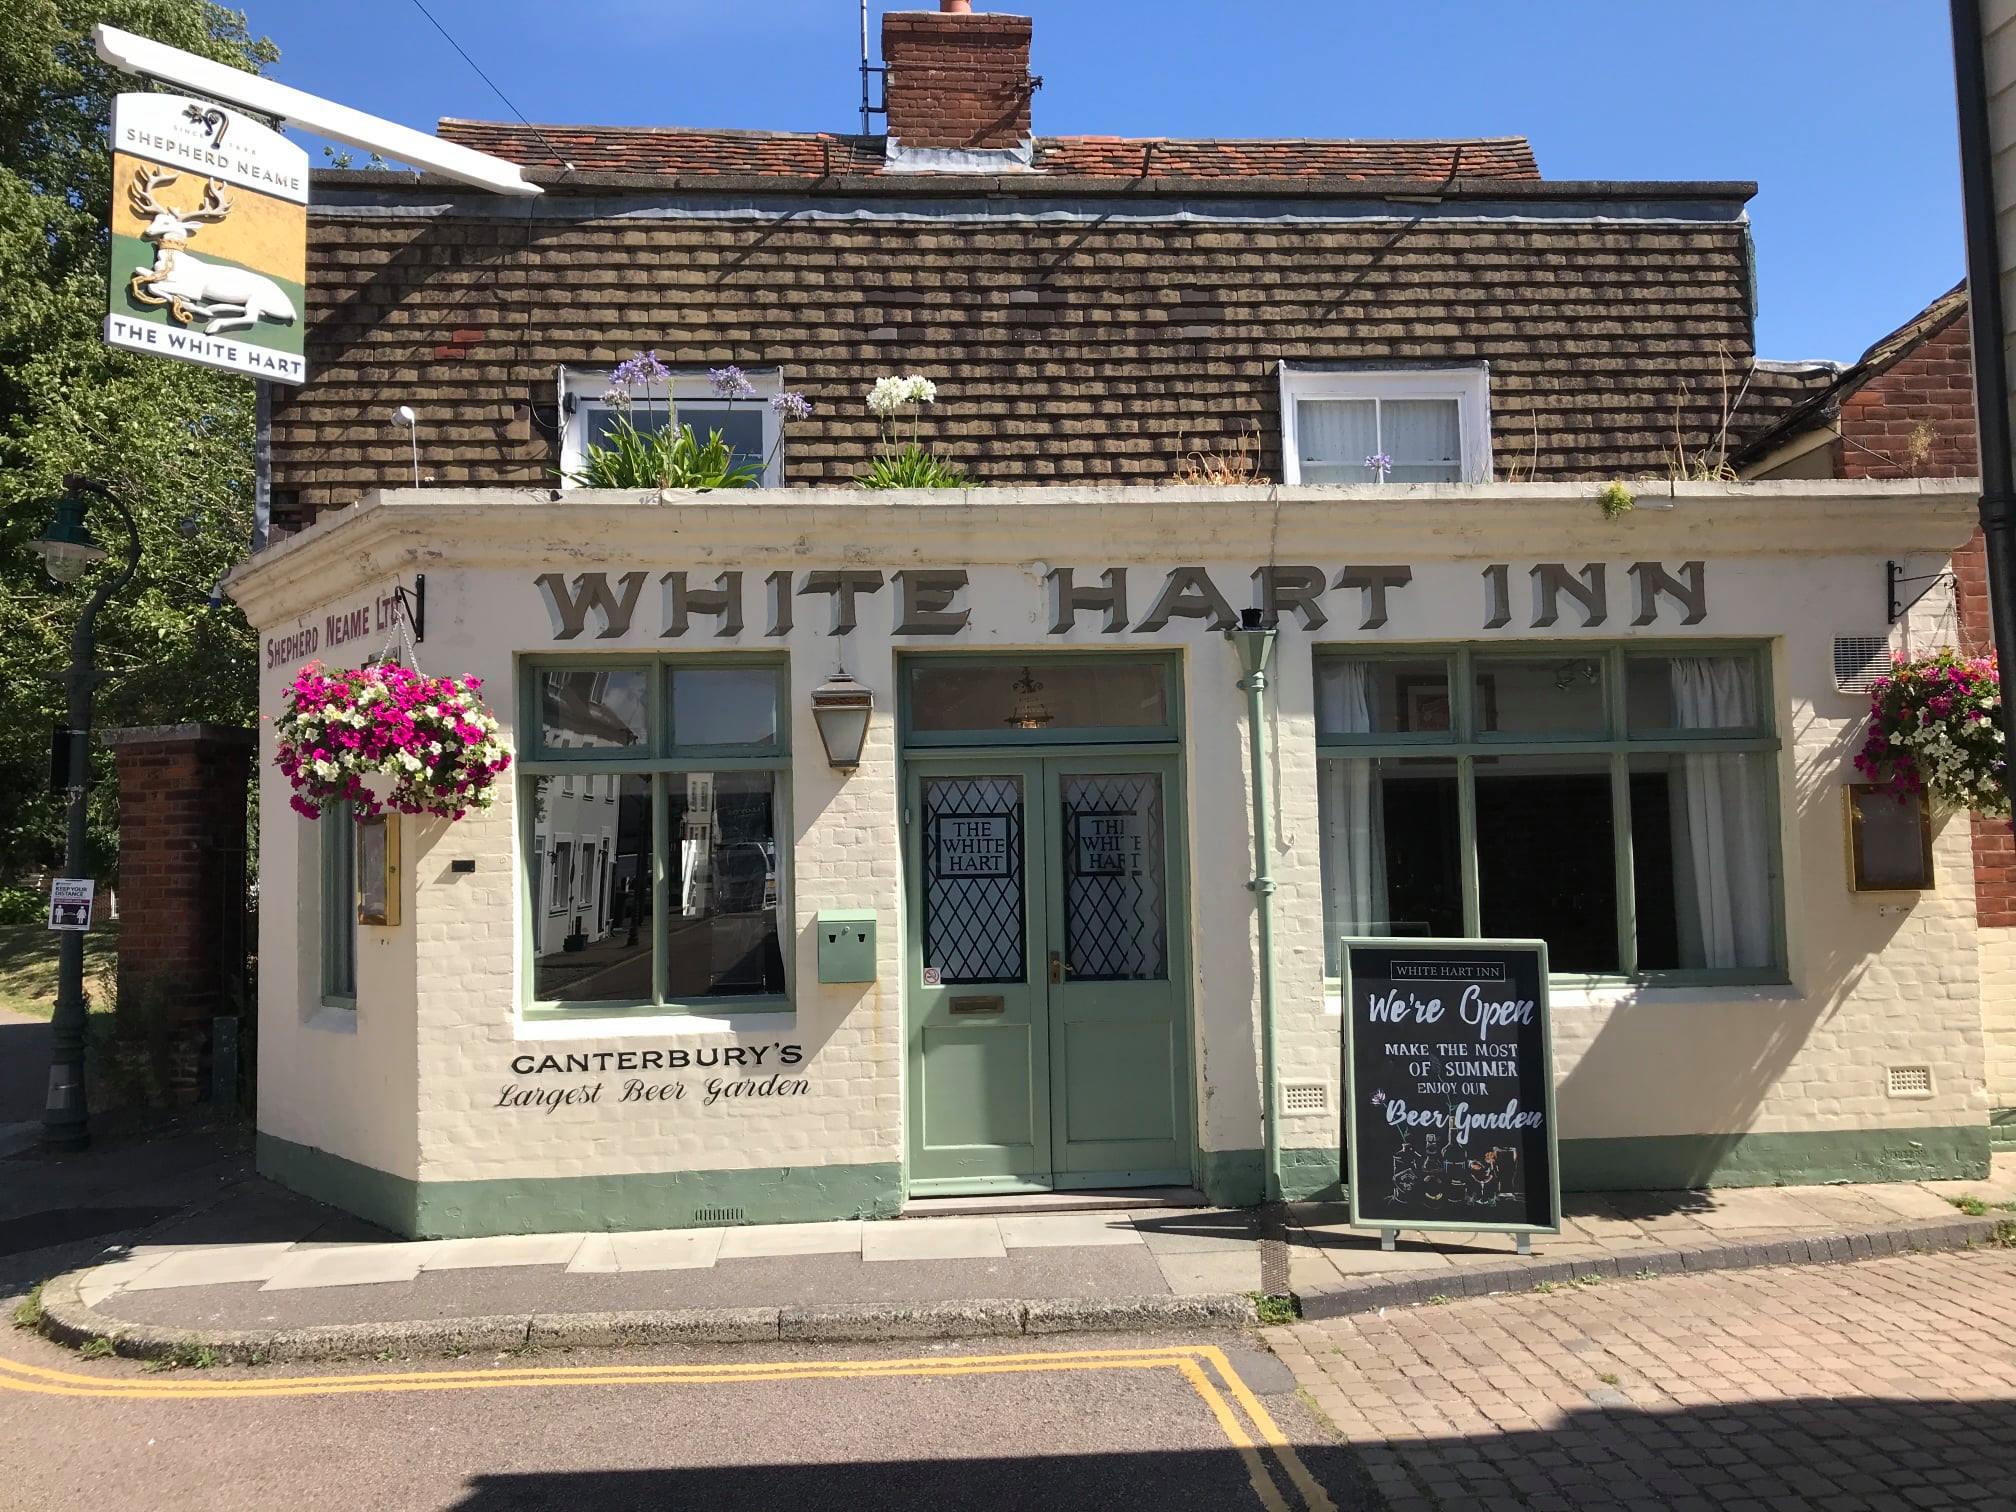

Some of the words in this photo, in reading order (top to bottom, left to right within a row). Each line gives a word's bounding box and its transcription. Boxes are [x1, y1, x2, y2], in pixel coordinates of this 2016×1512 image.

[127, 128, 229, 168] SHEPHERD
[237, 162, 299, 190] NEAME
[114, 322, 157, 344] THE
[168, 334, 237, 361] WHITE
[248, 352, 302, 374] HART
[533, 569, 971, 640] WHITE
[1046, 565, 1411, 634] HART
[1482, 561, 1708, 629] INN
[267, 627, 318, 669] SHEPHERD
[326, 606, 370, 647] NEAME
[952, 822, 992, 837] THE
[942, 838, 1005, 854] WHITE
[1081, 836, 1142, 852] WHIE
[950, 855, 1003, 871] HART
[1397, 966, 1438, 976] WHITE
[1441, 967, 1473, 976] HART
[1476, 967, 1499, 977] INN
[1369, 988, 1445, 1023] We're
[1460, 985, 1534, 1040] Open
[510, 1042, 803, 1075] CANTERBURY'S
[1385, 1043, 1429, 1056] MAKE
[1437, 1043, 1468, 1056] THE
[1475, 1043, 1518, 1057] MOST
[1409, 1061, 1431, 1076] OF
[1445, 1061, 1518, 1077] SUMMER
[494, 1082, 603, 1115] Largest
[618, 1078, 687, 1102] Beer
[703, 1073, 810, 1106] Garden
[1417, 1082, 1458, 1094] ENJOY
[1461, 1082, 1489, 1096] OUR
[1386, 1099, 1450, 1128] Beer
[1454, 1098, 1543, 1144] Garden
